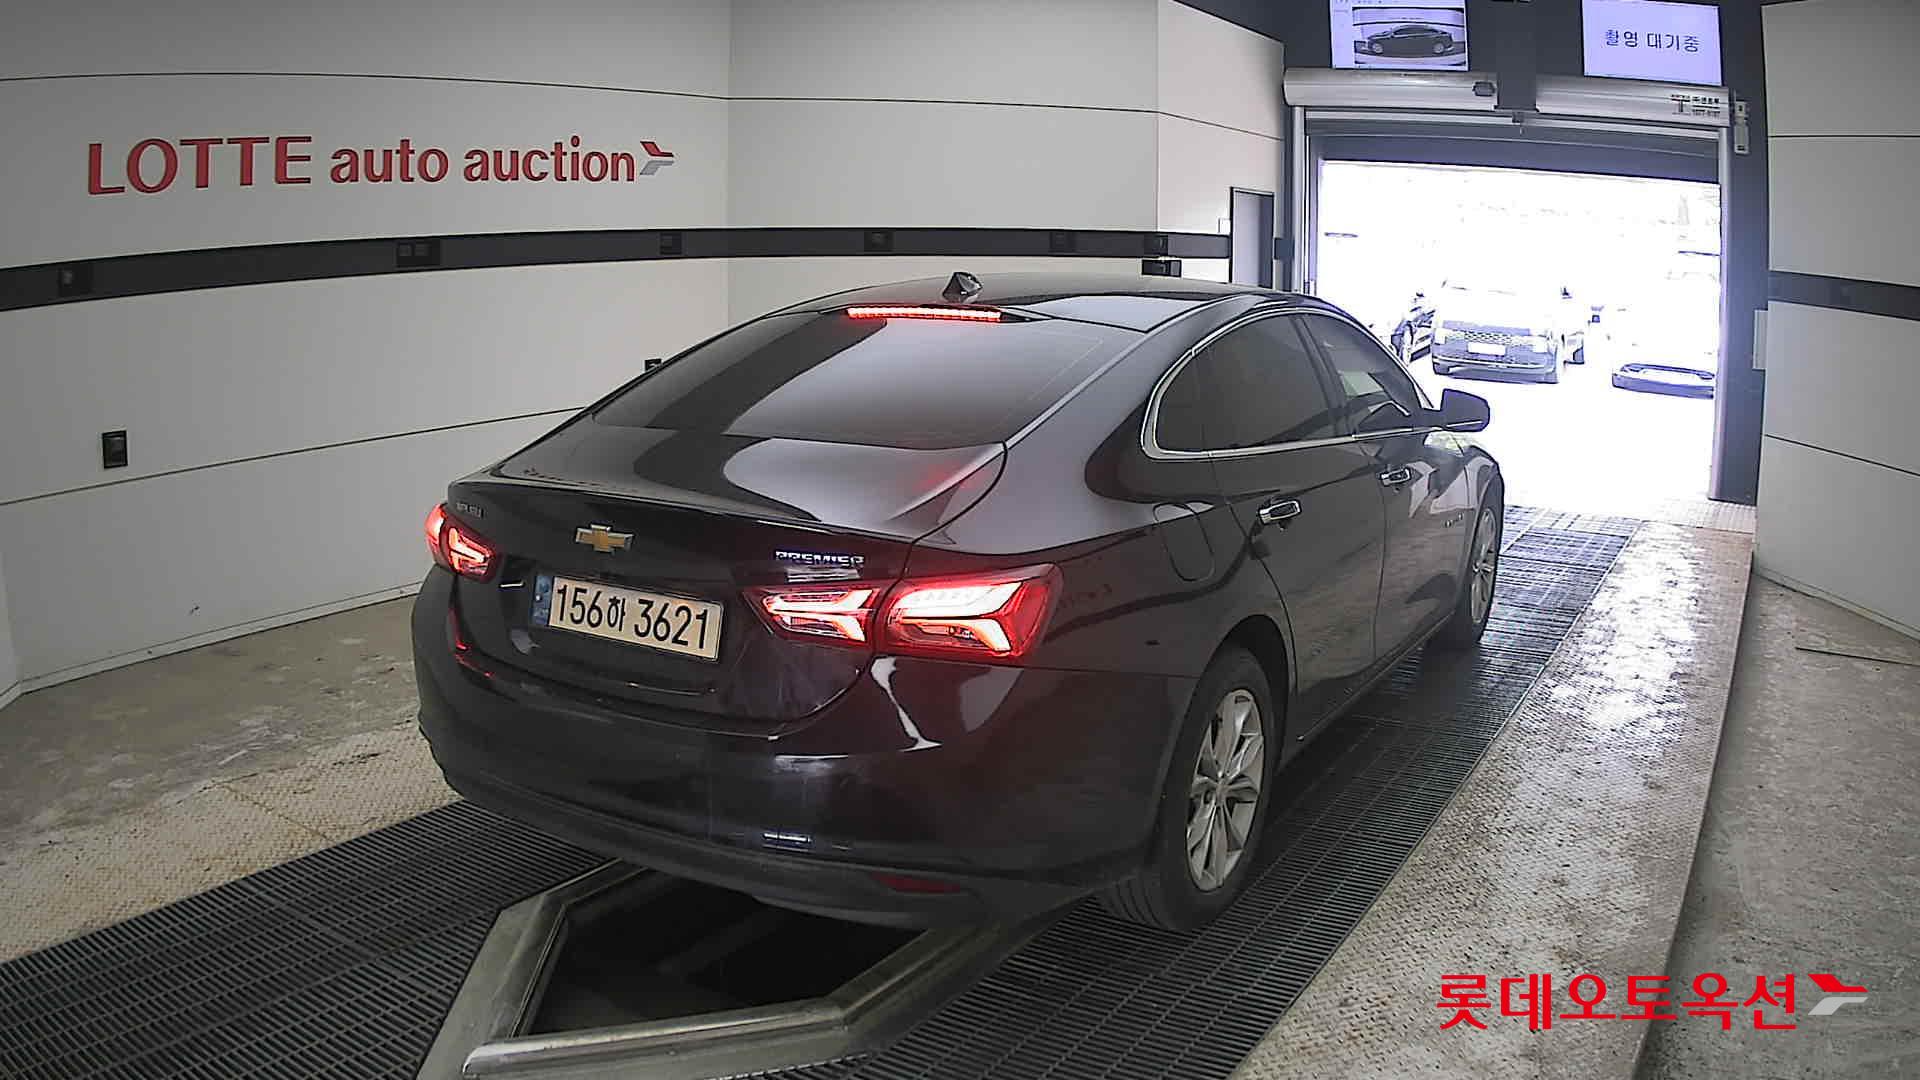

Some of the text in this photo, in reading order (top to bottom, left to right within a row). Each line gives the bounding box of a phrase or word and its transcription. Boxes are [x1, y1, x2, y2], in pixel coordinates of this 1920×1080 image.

[1646, 32, 1700, 53] 대기중
[88, 135, 635, 195] LOTTE auto auction
[557, 584, 708, 649] 156하 3621
